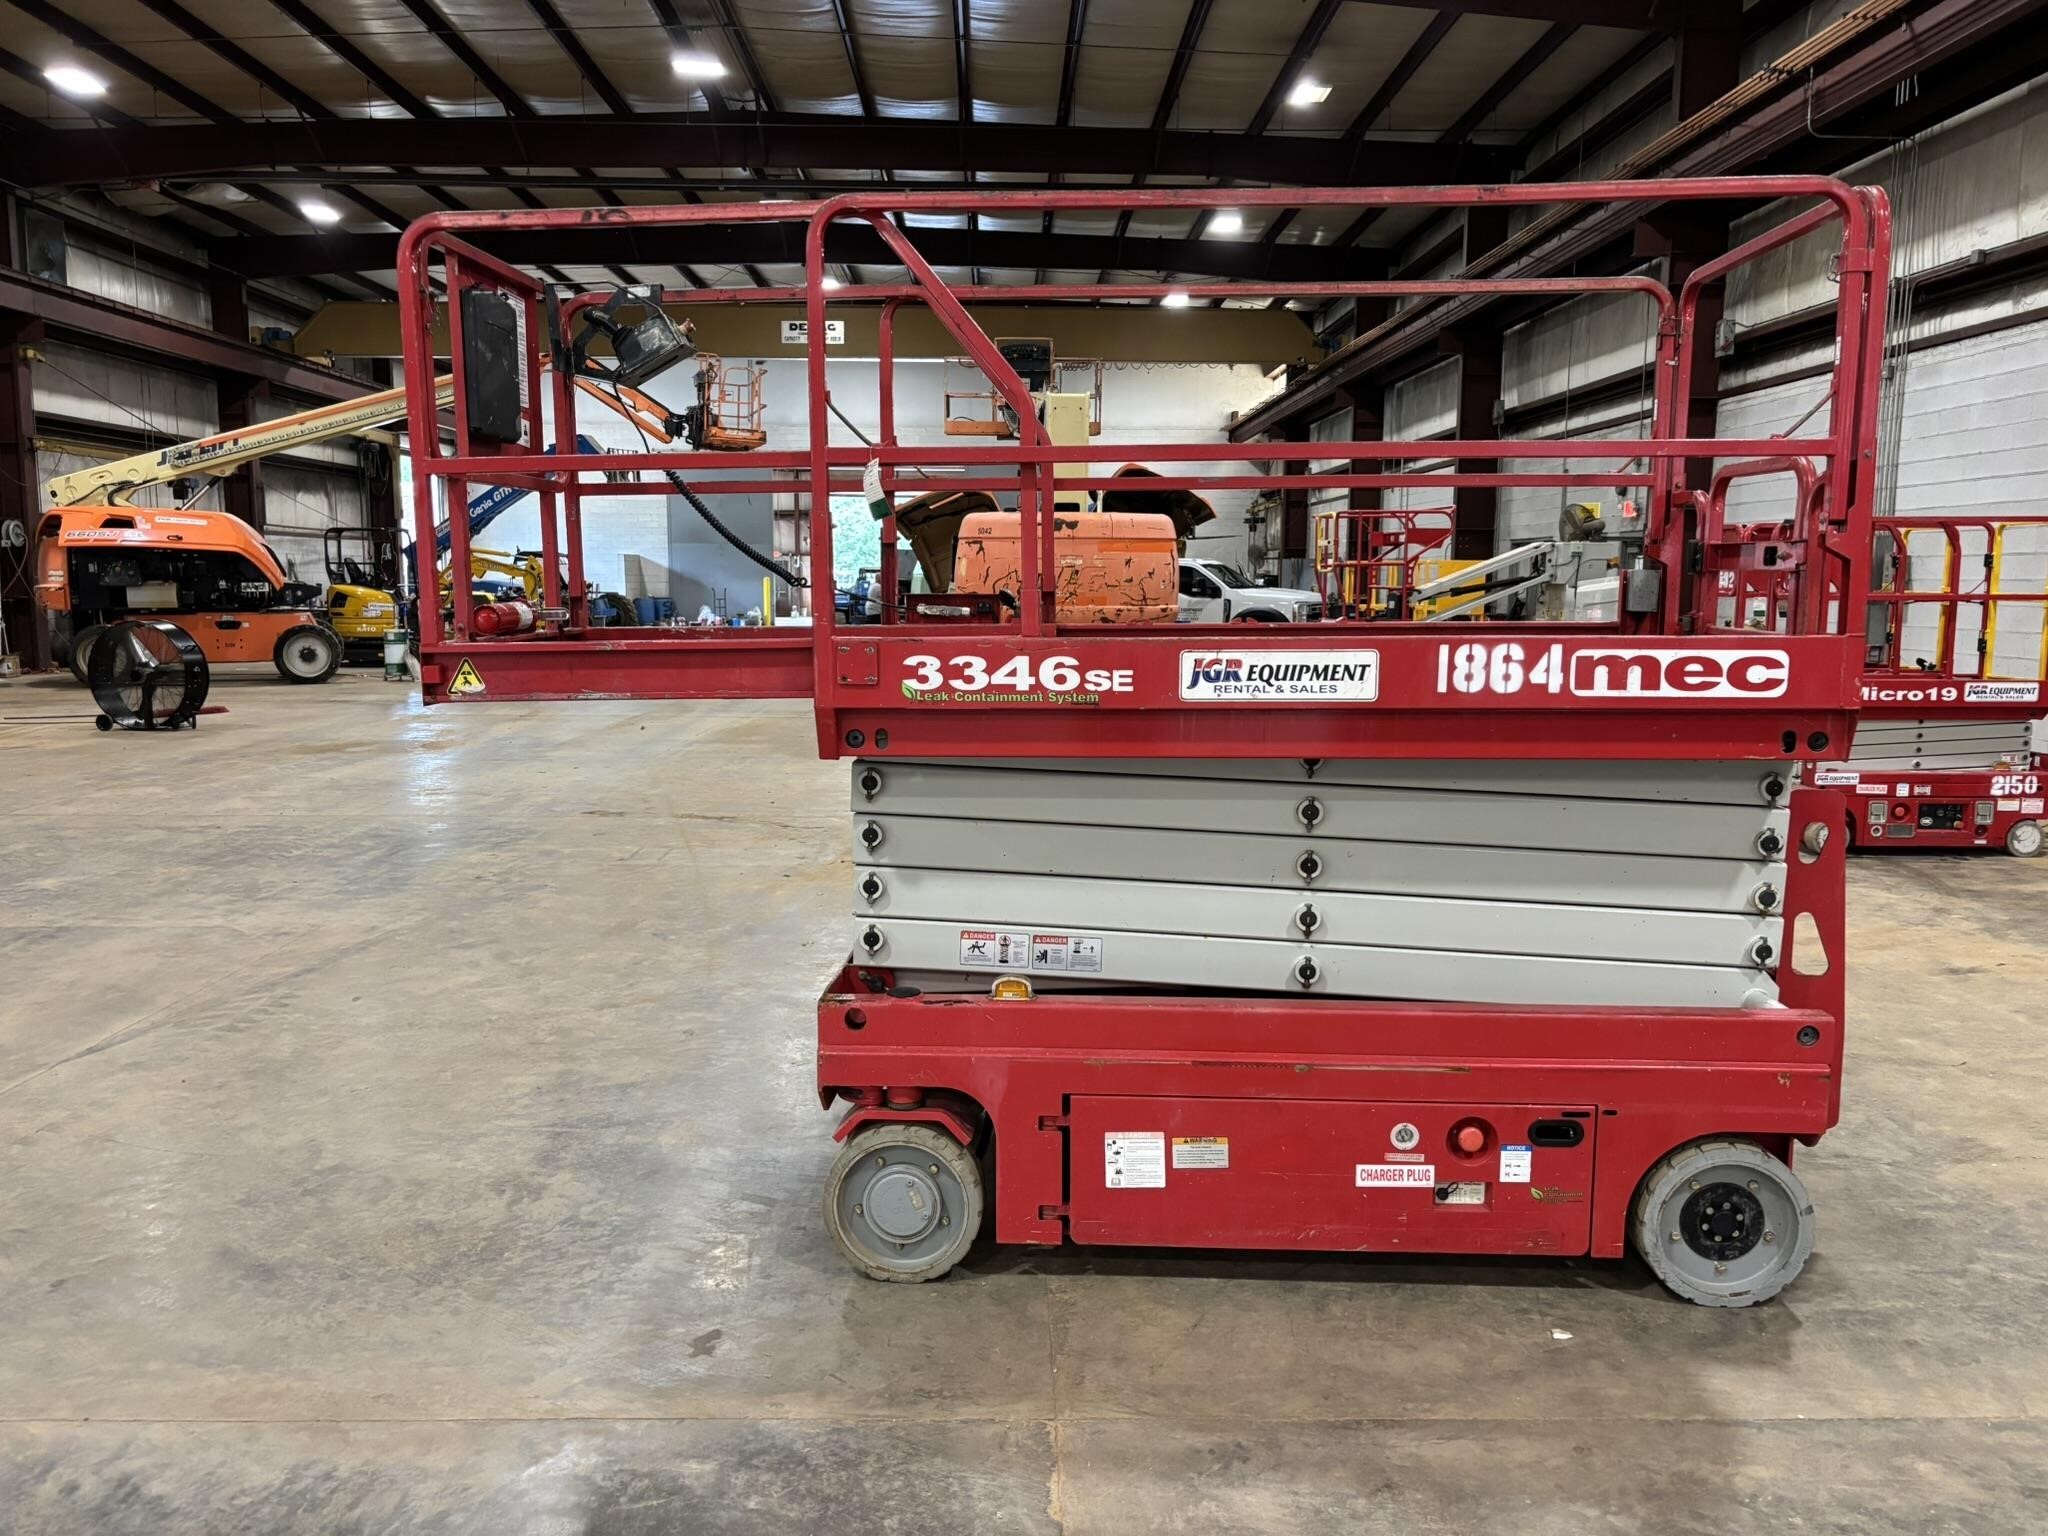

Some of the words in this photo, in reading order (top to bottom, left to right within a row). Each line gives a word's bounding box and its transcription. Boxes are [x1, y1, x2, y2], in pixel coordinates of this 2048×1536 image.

[789, 323, 836, 331] DEG
[469, 499, 494, 517] Genie
[1187, 658, 1243, 689] JGR
[1246, 664, 1371, 687] EQUIPMENT
[1436, 643, 1564, 695] 1864
[1574, 654, 1786, 692] mec
[1213, 685, 1270, 693] RENTAL
[1275, 685, 1285, 693] &
[1290, 685, 1338, 693] SALES
[1989, 687, 2037, 696] EQUIPMENT
[917, 691, 949, 701] Leak
[954, 691, 1043, 702] Containment
[1048, 692, 1099, 705] System
[1990, 775, 2038, 796] 2150
[1360, 1168, 1404, 1182] CHARGER
[1407, 1169, 1431, 1182] PLUG
